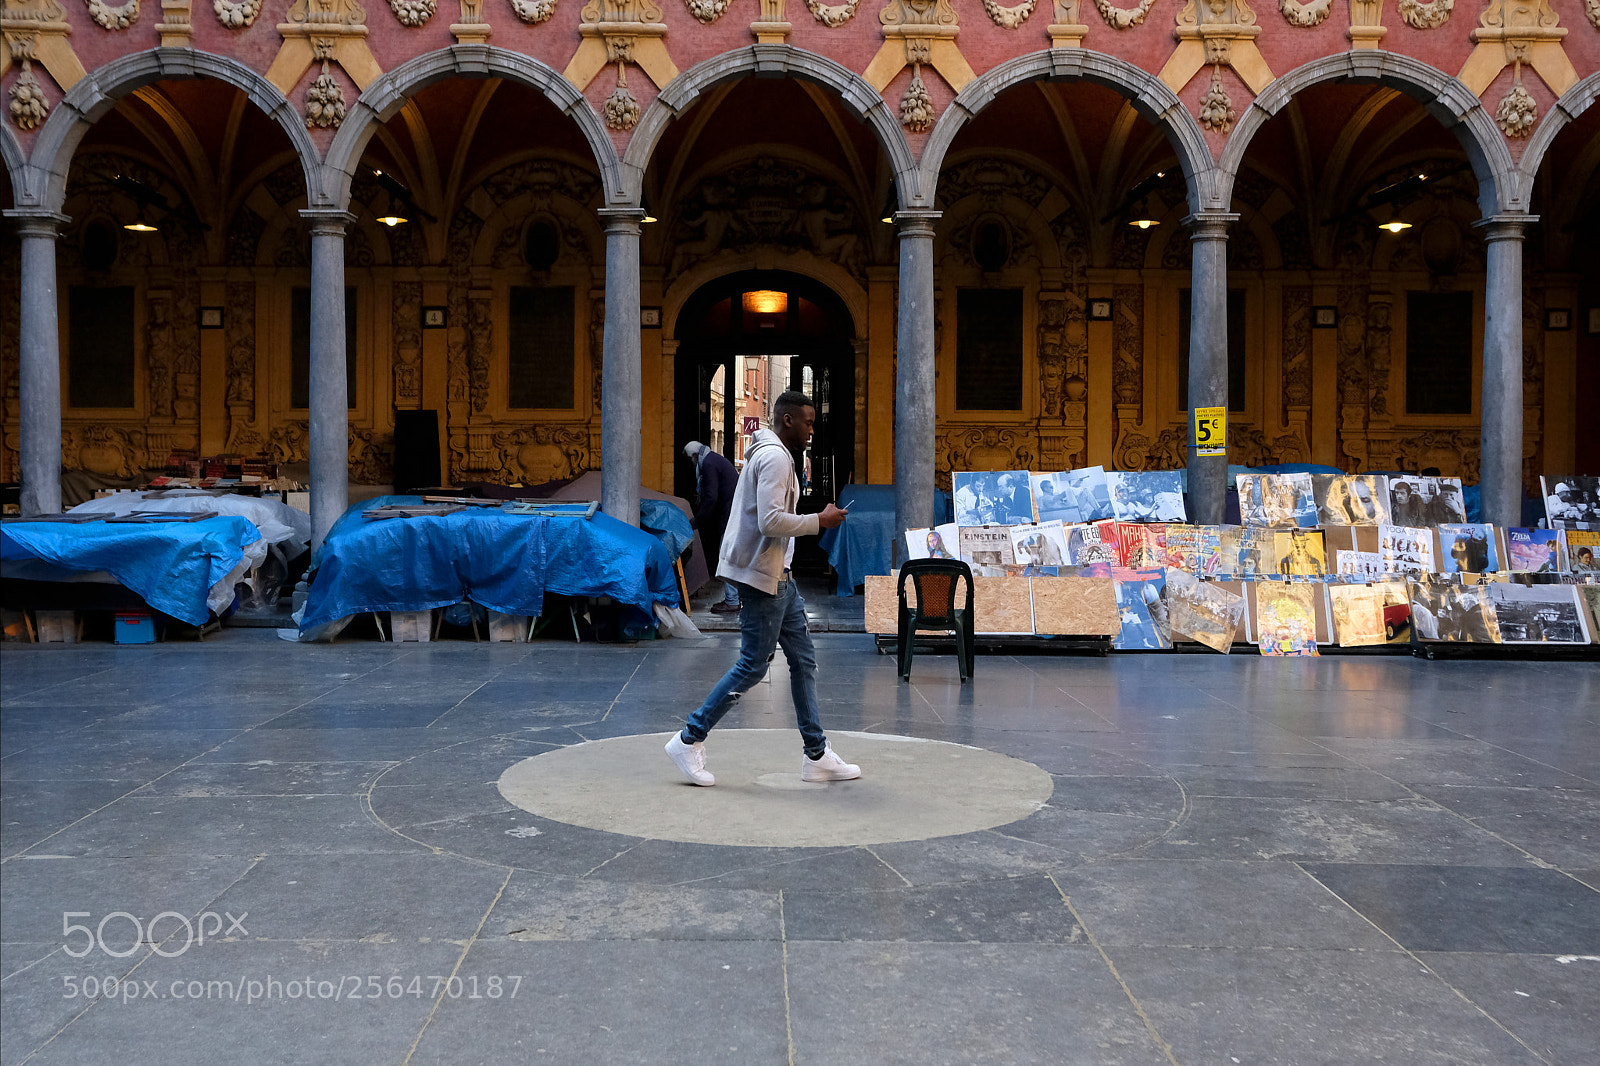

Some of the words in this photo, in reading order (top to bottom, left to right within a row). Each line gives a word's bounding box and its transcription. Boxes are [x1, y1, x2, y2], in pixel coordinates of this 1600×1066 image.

[646, 312, 654, 323] 5
[1198, 419, 1219, 441] 5€
[1385, 525, 1407, 534] YOGA
[964, 533, 1008, 541] EINSTEIN
[1511, 531, 1531, 542] ZELDA
